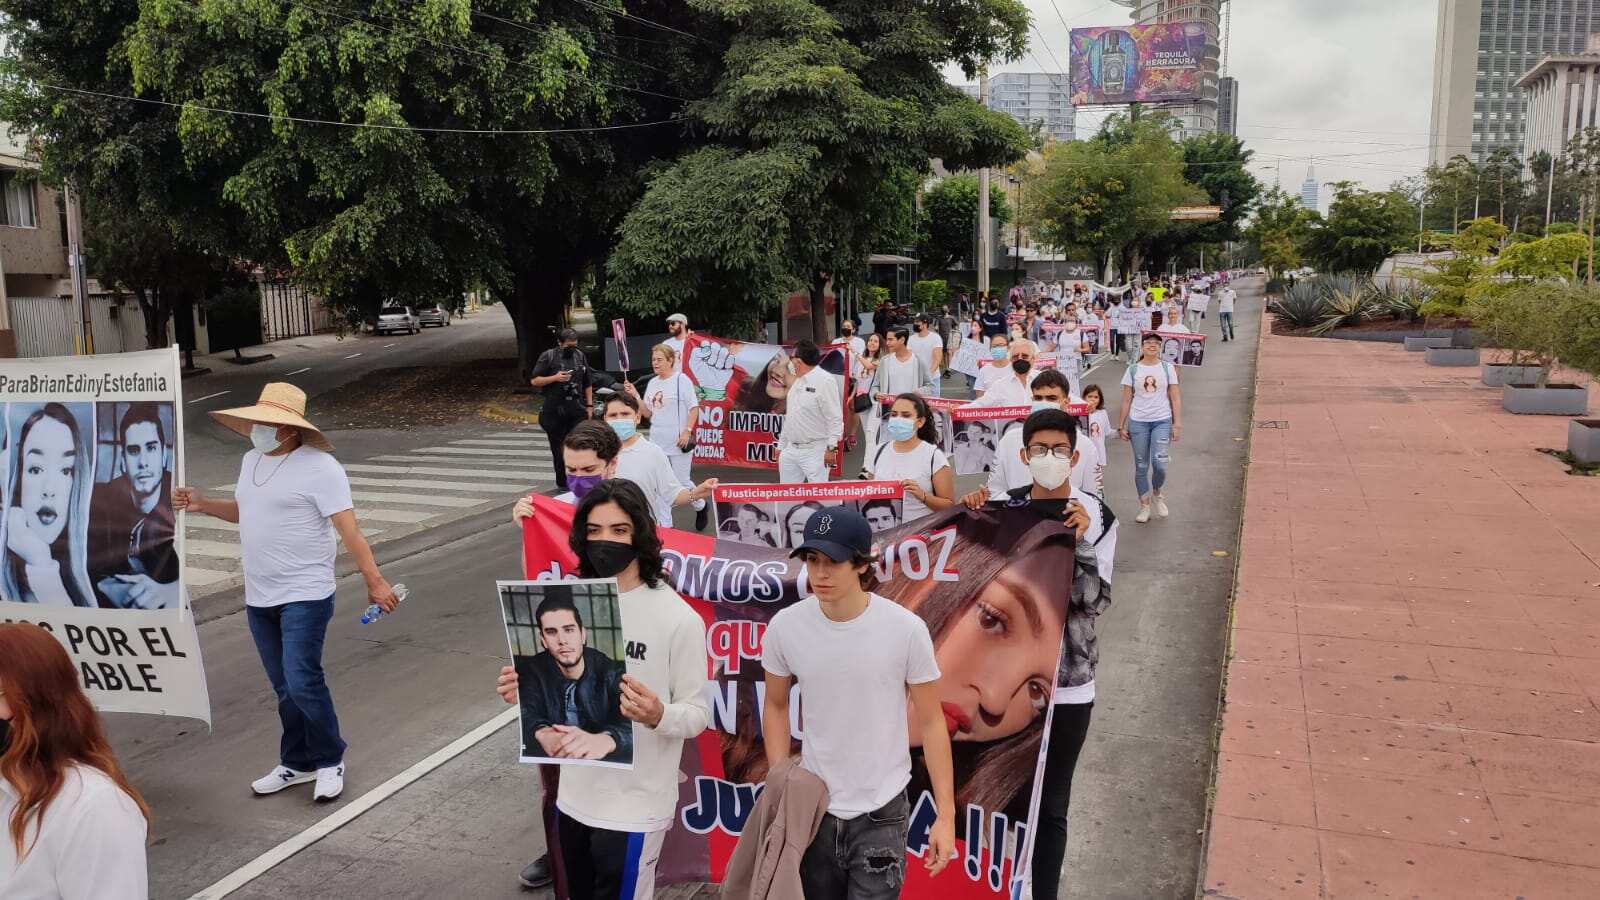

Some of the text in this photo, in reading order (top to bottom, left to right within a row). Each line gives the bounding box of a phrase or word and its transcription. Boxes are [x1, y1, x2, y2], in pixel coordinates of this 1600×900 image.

[699, 406, 724, 427] NO
[729, 411, 784, 433] IMPUN
[695, 427, 724, 444] PUEDE
[694, 445, 725, 459] QUEDAR
[721, 485, 895, 499] #JusticiaparaEdinEstefaniayBrian
[660, 549, 787, 603] OMOS
[64, 624, 187, 658] POR EL
[625, 640, 647, 660] AR
[81, 661, 162, 692] ABLE
